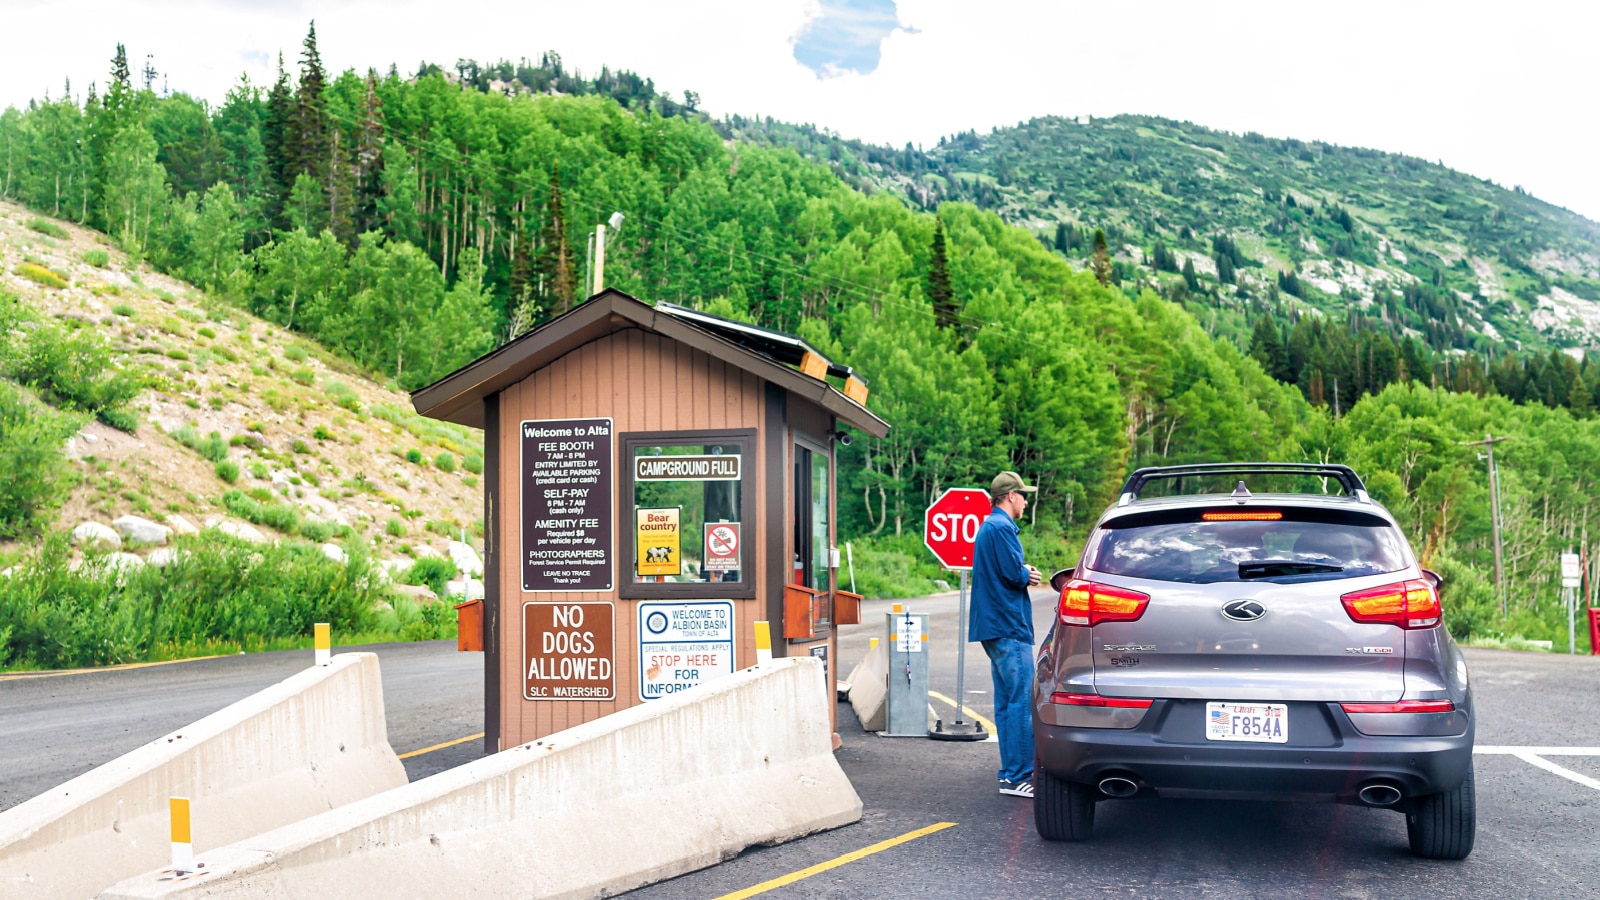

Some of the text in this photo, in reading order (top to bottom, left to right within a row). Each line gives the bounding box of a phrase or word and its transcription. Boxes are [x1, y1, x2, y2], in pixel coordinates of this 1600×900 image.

[525, 426, 608, 437] Welcome to Alta
[539, 441, 594, 451] FEE BOOTH
[640, 461, 736, 476] CAMPGROUND FULL
[544, 489, 589, 498] SELF-PAY
[647, 514, 669, 522] Bear
[535, 519, 599, 528] AMENITY FEE
[640, 523, 676, 532] country
[931, 513, 990, 543] STO
[530, 550, 604, 558] PHOTOGRAPHERS
[553, 605, 584, 628] NO
[672, 610, 725, 619] WELCOME TO
[672, 621, 701, 629] ALBION
[704, 620, 727, 629] BASIN
[543, 631, 594, 654] DOGS
[652, 655, 717, 666] STOP HERE
[528, 658, 610, 680] ALLOWED
[675, 670, 699, 679] FOR
[530, 687, 609, 696] SLC WATERSHED
[1232, 716, 1281, 736] F854A
